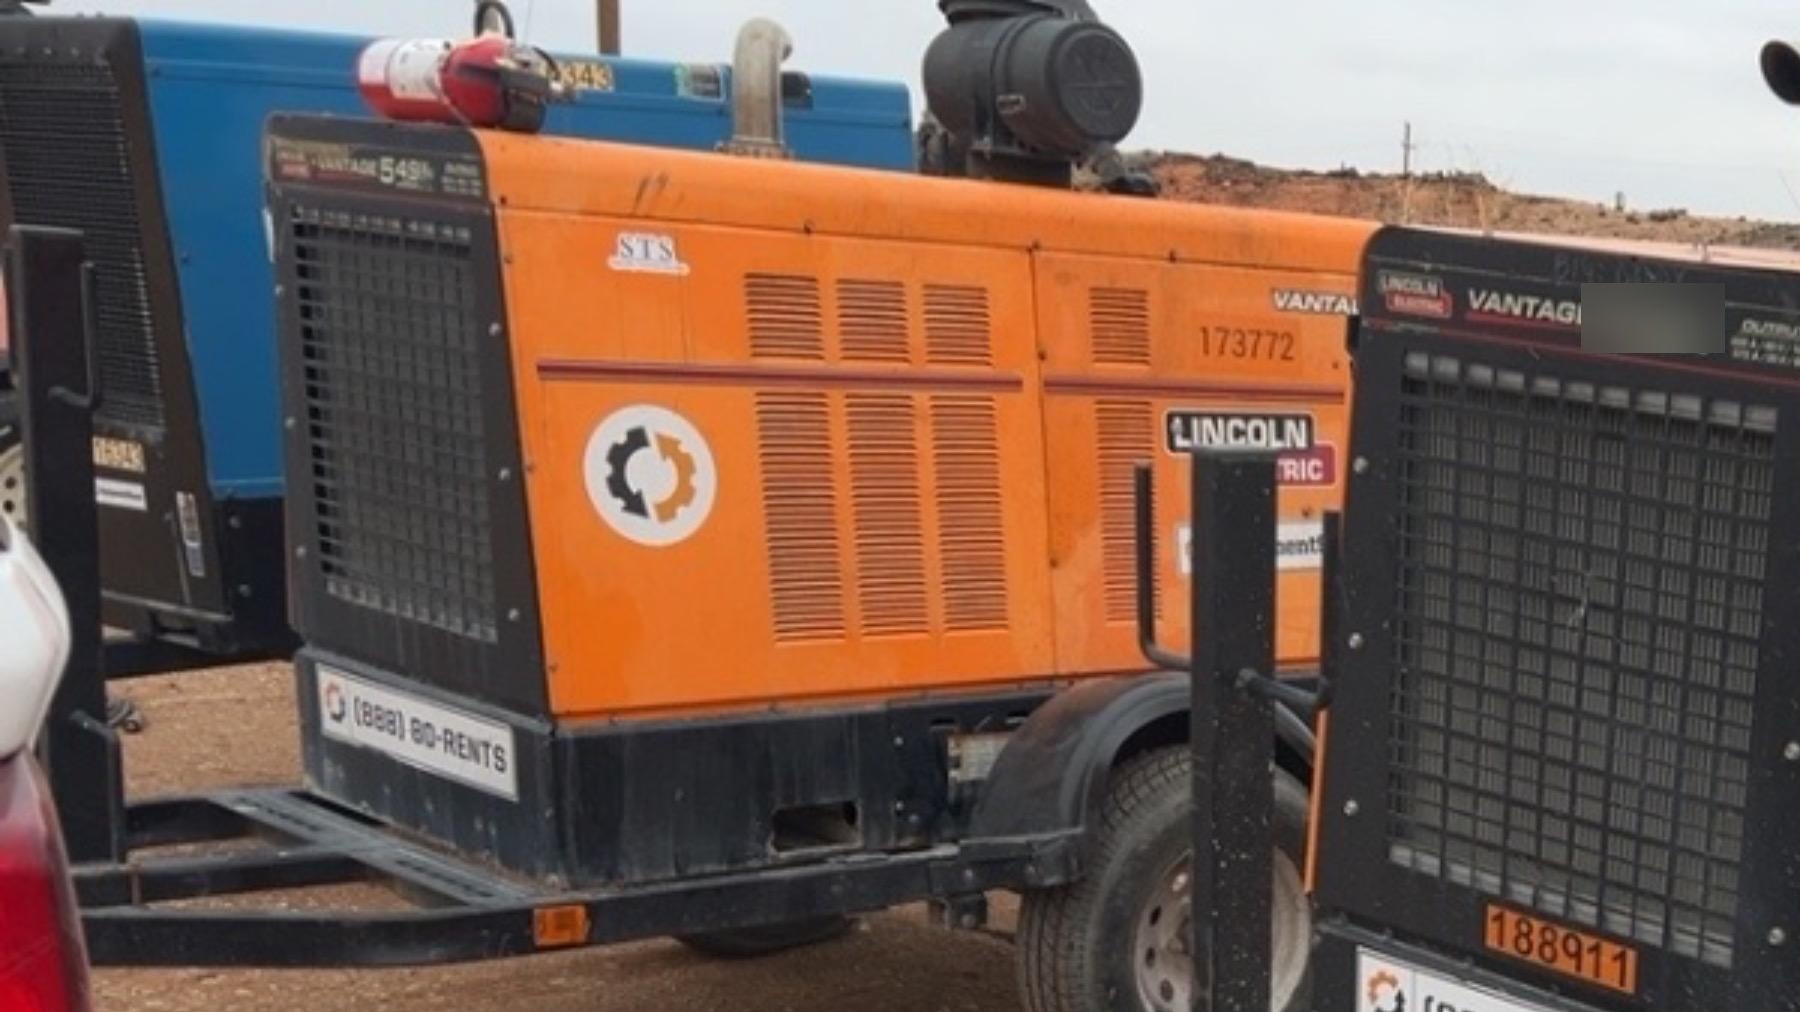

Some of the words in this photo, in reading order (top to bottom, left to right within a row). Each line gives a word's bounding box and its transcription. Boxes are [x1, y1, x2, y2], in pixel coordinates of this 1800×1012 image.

[620, 235, 673, 261] STS
[1468, 288, 1581, 325] VANTAG
[1199, 326, 1295, 361] 173772
[1174, 416, 1307, 449] LINCOLN
[411, 717, 507, 774] 80-RENTS
[1490, 910, 1629, 988] 188911
